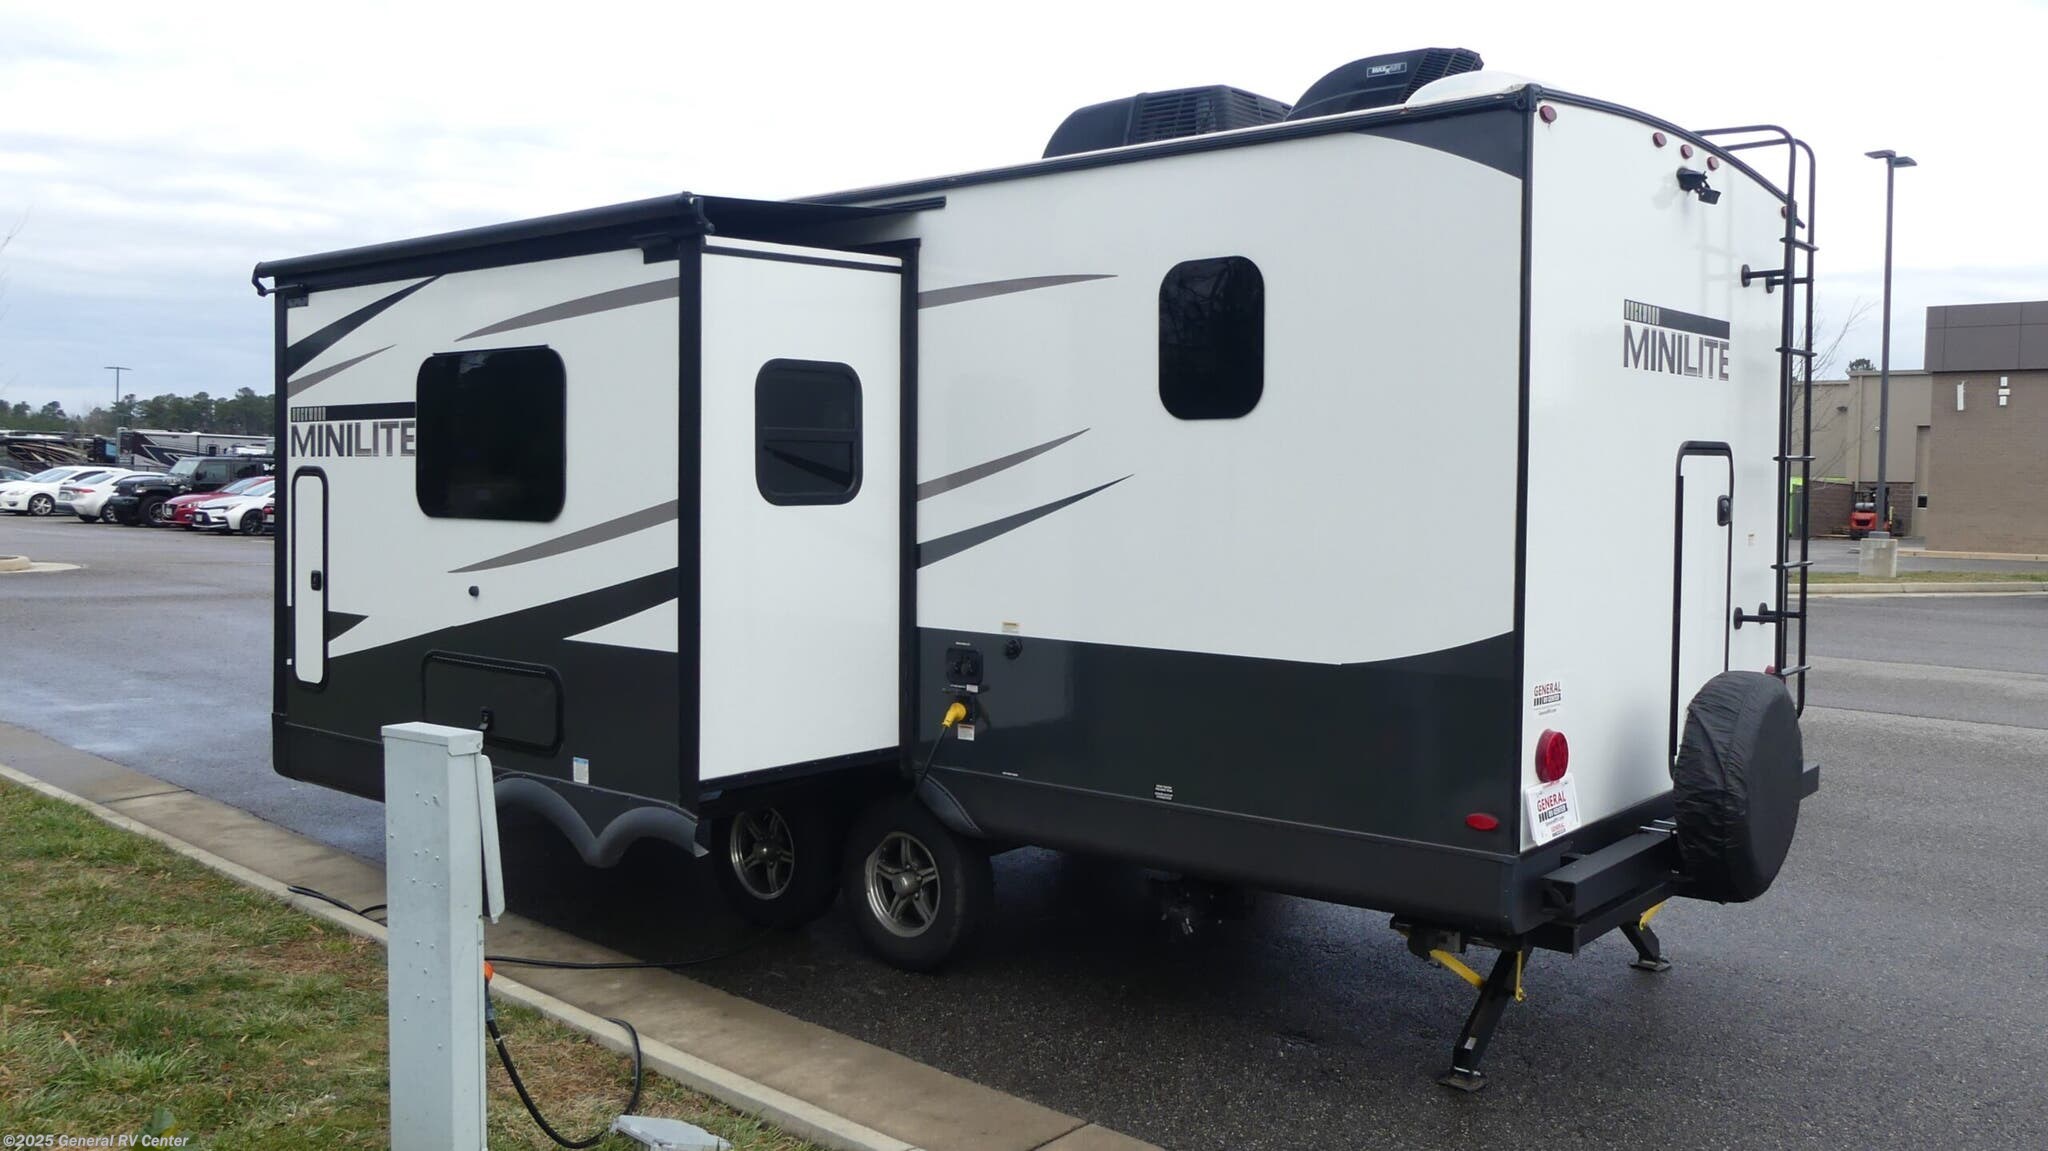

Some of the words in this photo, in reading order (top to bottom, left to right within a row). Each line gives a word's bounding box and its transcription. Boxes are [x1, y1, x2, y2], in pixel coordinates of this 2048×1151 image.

[1623, 324, 1730, 381] MINILITE
[291, 421, 416, 457] MINILITE
[1534, 681, 1561, 697] GENERAL
[1537, 791, 1566, 812] GENERAL
